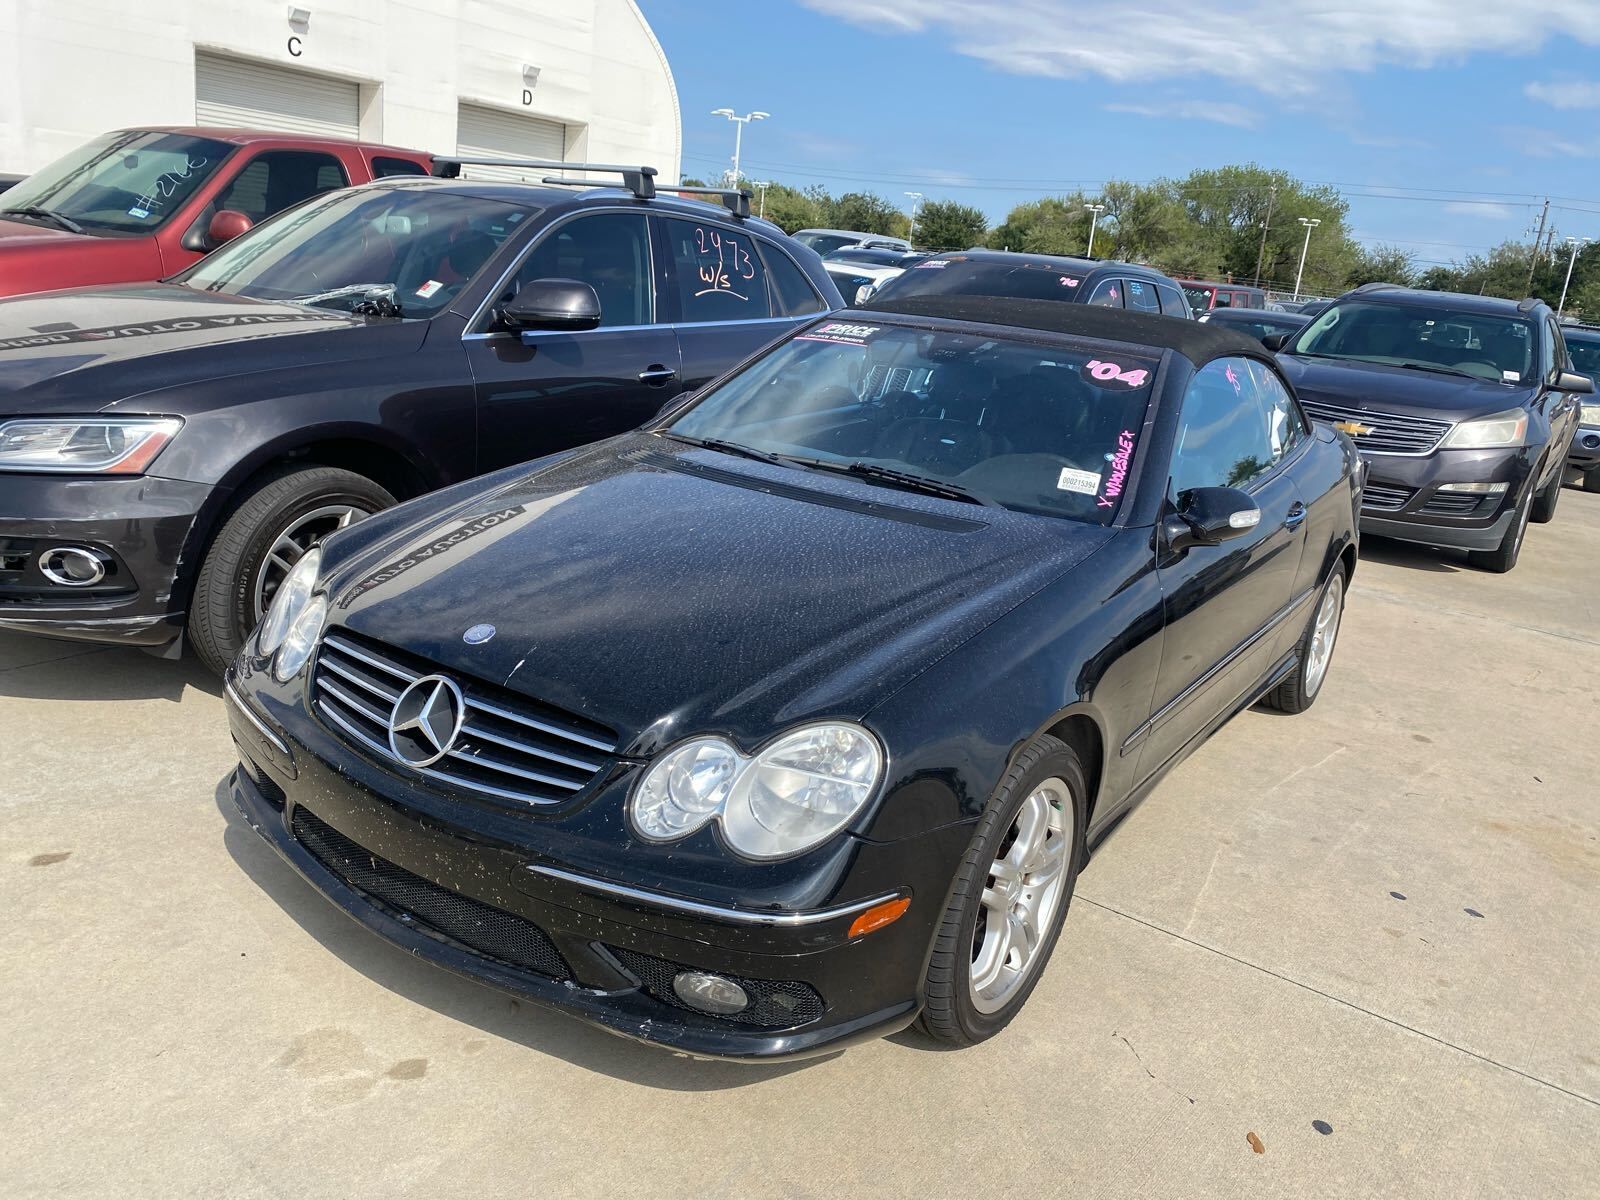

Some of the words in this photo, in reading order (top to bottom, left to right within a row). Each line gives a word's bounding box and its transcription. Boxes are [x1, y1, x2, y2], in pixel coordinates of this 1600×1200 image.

[287, 36, 303, 57] C
[522, 90, 533, 106] D
[695, 227, 755, 279] 2473
[1106, 436, 1134, 496] WHOLESALE
